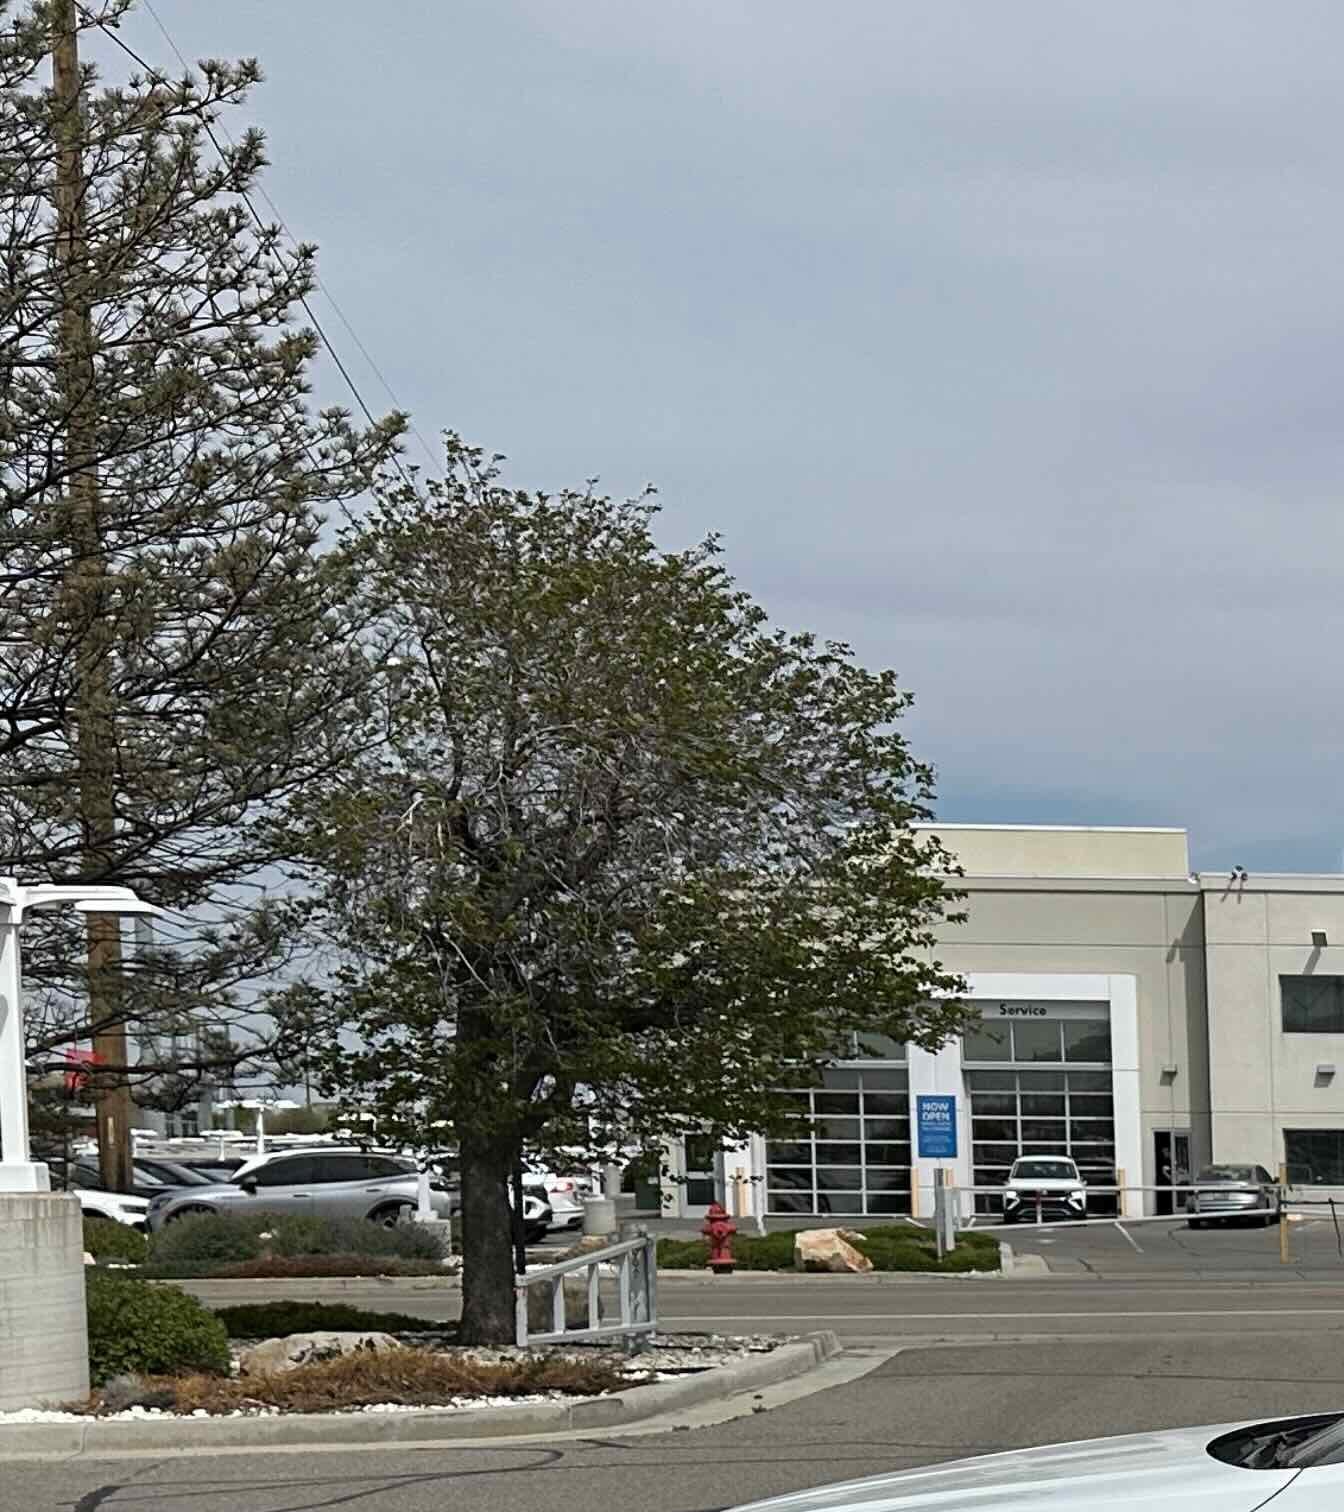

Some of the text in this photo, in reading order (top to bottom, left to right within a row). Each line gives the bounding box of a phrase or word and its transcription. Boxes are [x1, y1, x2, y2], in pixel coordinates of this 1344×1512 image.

[1000, 1003, 1047, 1016] Service
[922, 1102, 949, 1112] NOW
[922, 1112, 951, 1121] OPEN
